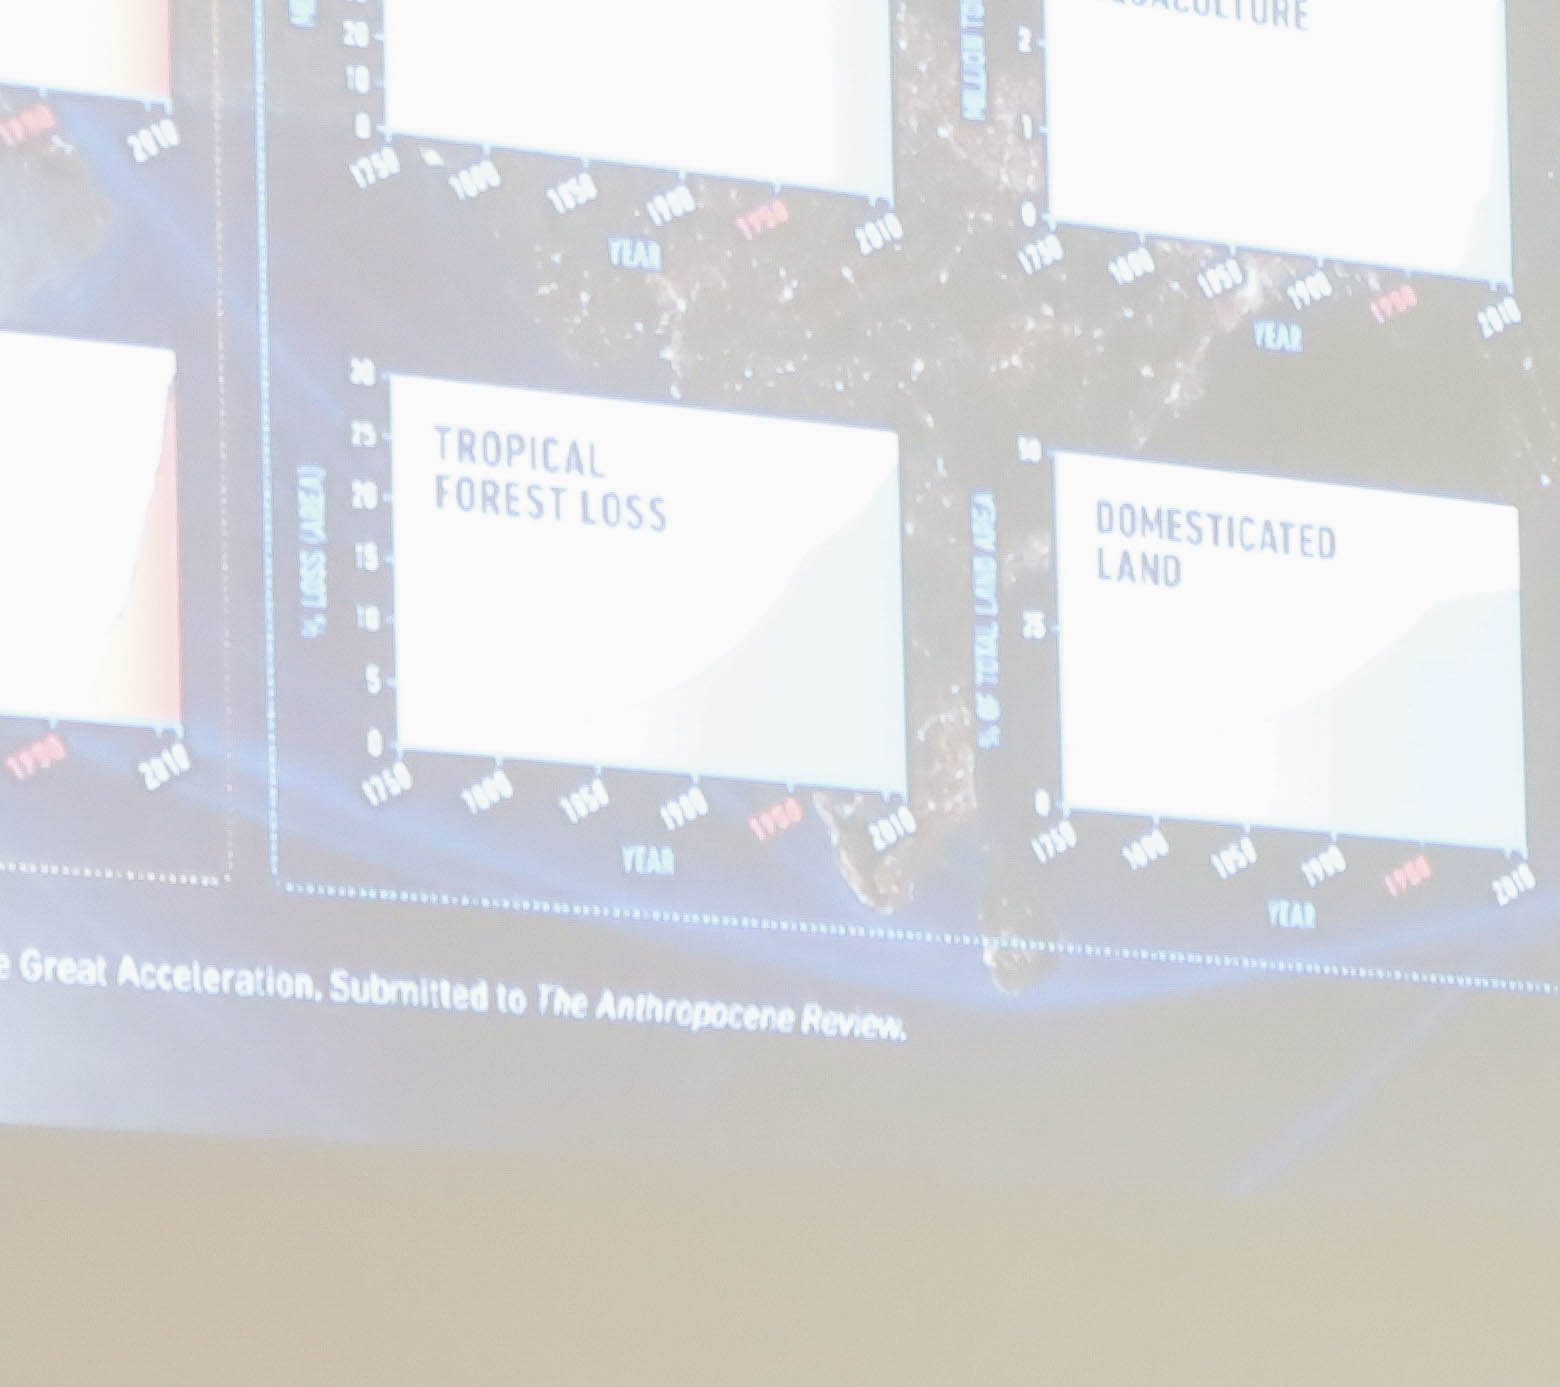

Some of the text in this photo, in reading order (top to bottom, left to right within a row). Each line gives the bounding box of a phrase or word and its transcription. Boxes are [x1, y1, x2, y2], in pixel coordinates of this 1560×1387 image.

[608, 236, 662, 272] YEAR
[1253, 320, 1303, 353] YEAR
[433, 424, 607, 479] TROPICAL
[433, 474, 669, 534] FOREST LOSS
[1095, 498, 1339, 561] DOMESTICATED
[1096, 546, 1183, 589] LAND
[622, 844, 675, 876] YEAR
[1267, 898, 1317, 929] YEAR
[19, 946, 107, 987] Great
[330, 968, 489, 1013] Submitted
[496, 981, 527, 1016] to
[537, 983, 588, 1019] The
[595, 988, 797, 1033] Anthropocene
[801, 1000, 907, 1041] Review.
